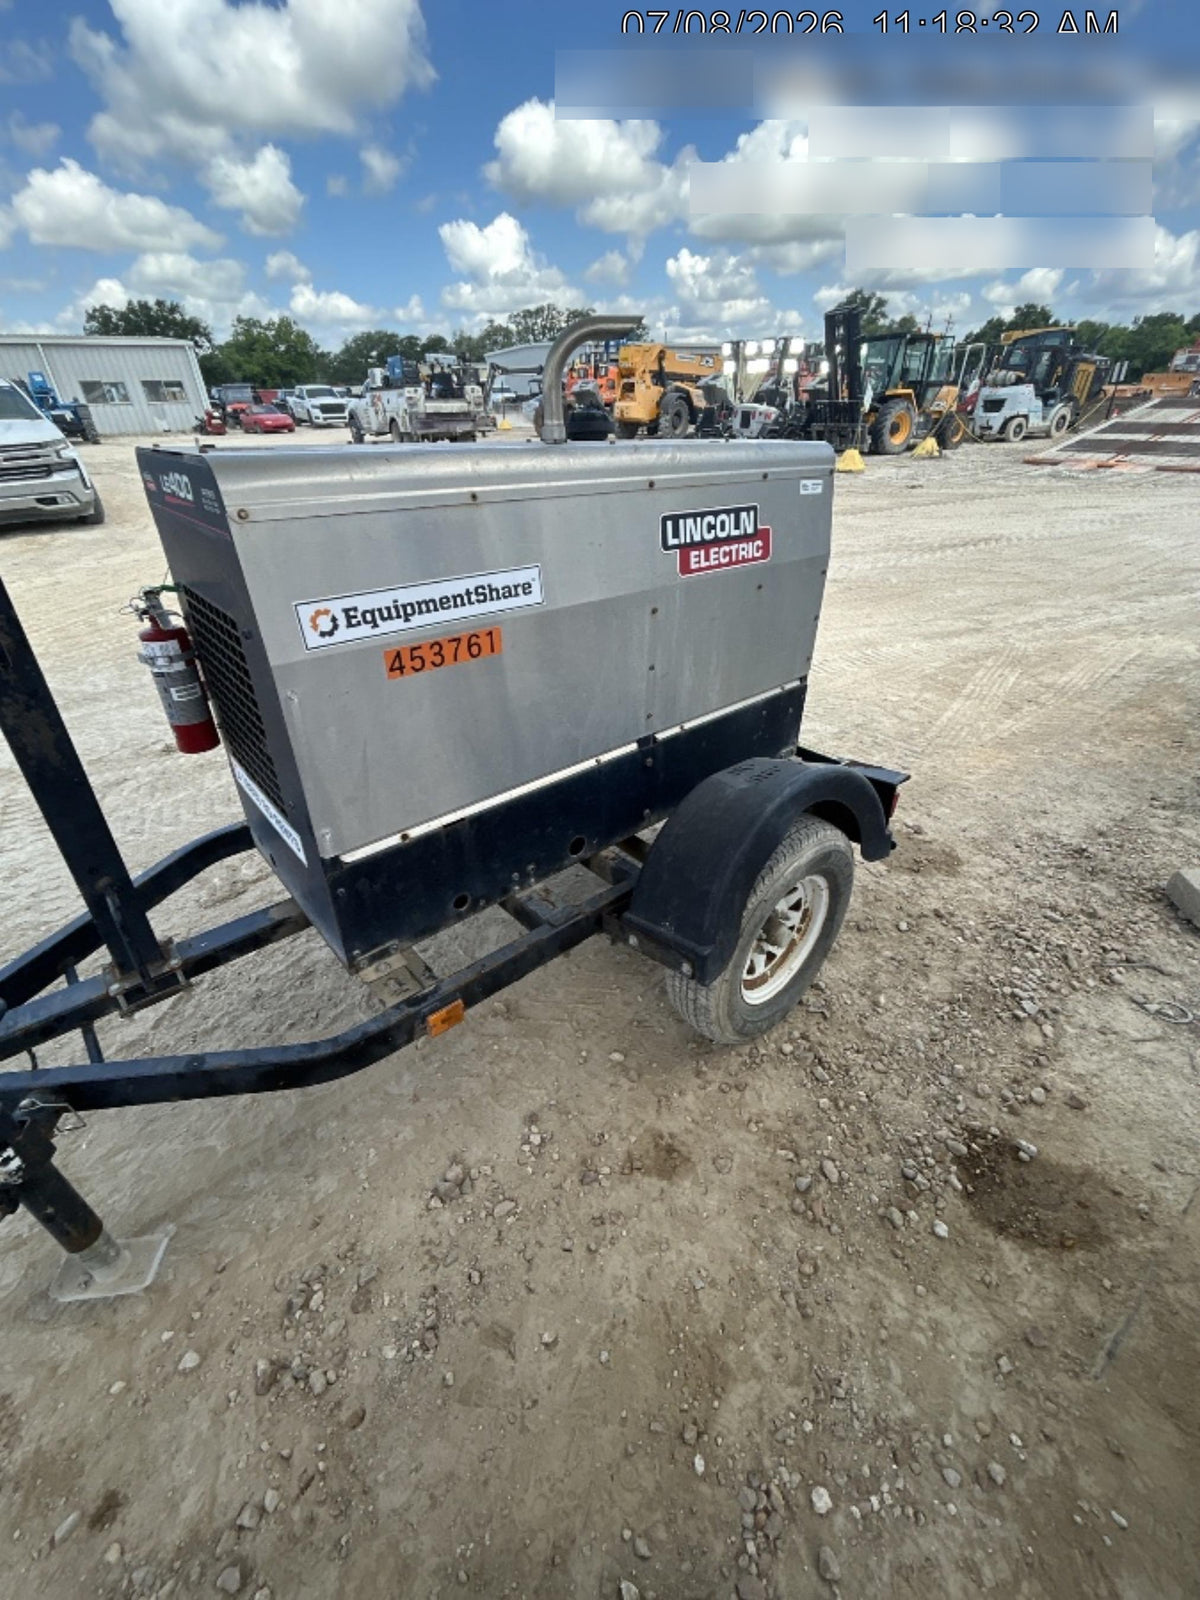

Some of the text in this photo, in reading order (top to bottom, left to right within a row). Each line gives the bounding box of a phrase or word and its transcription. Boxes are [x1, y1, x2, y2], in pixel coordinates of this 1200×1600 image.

[665, 509, 755, 546] LINCOLN
[689, 540, 764, 570] ELECTRIC
[340, 580, 534, 629] EquipmentShare
[388, 630, 497, 676] 453761
